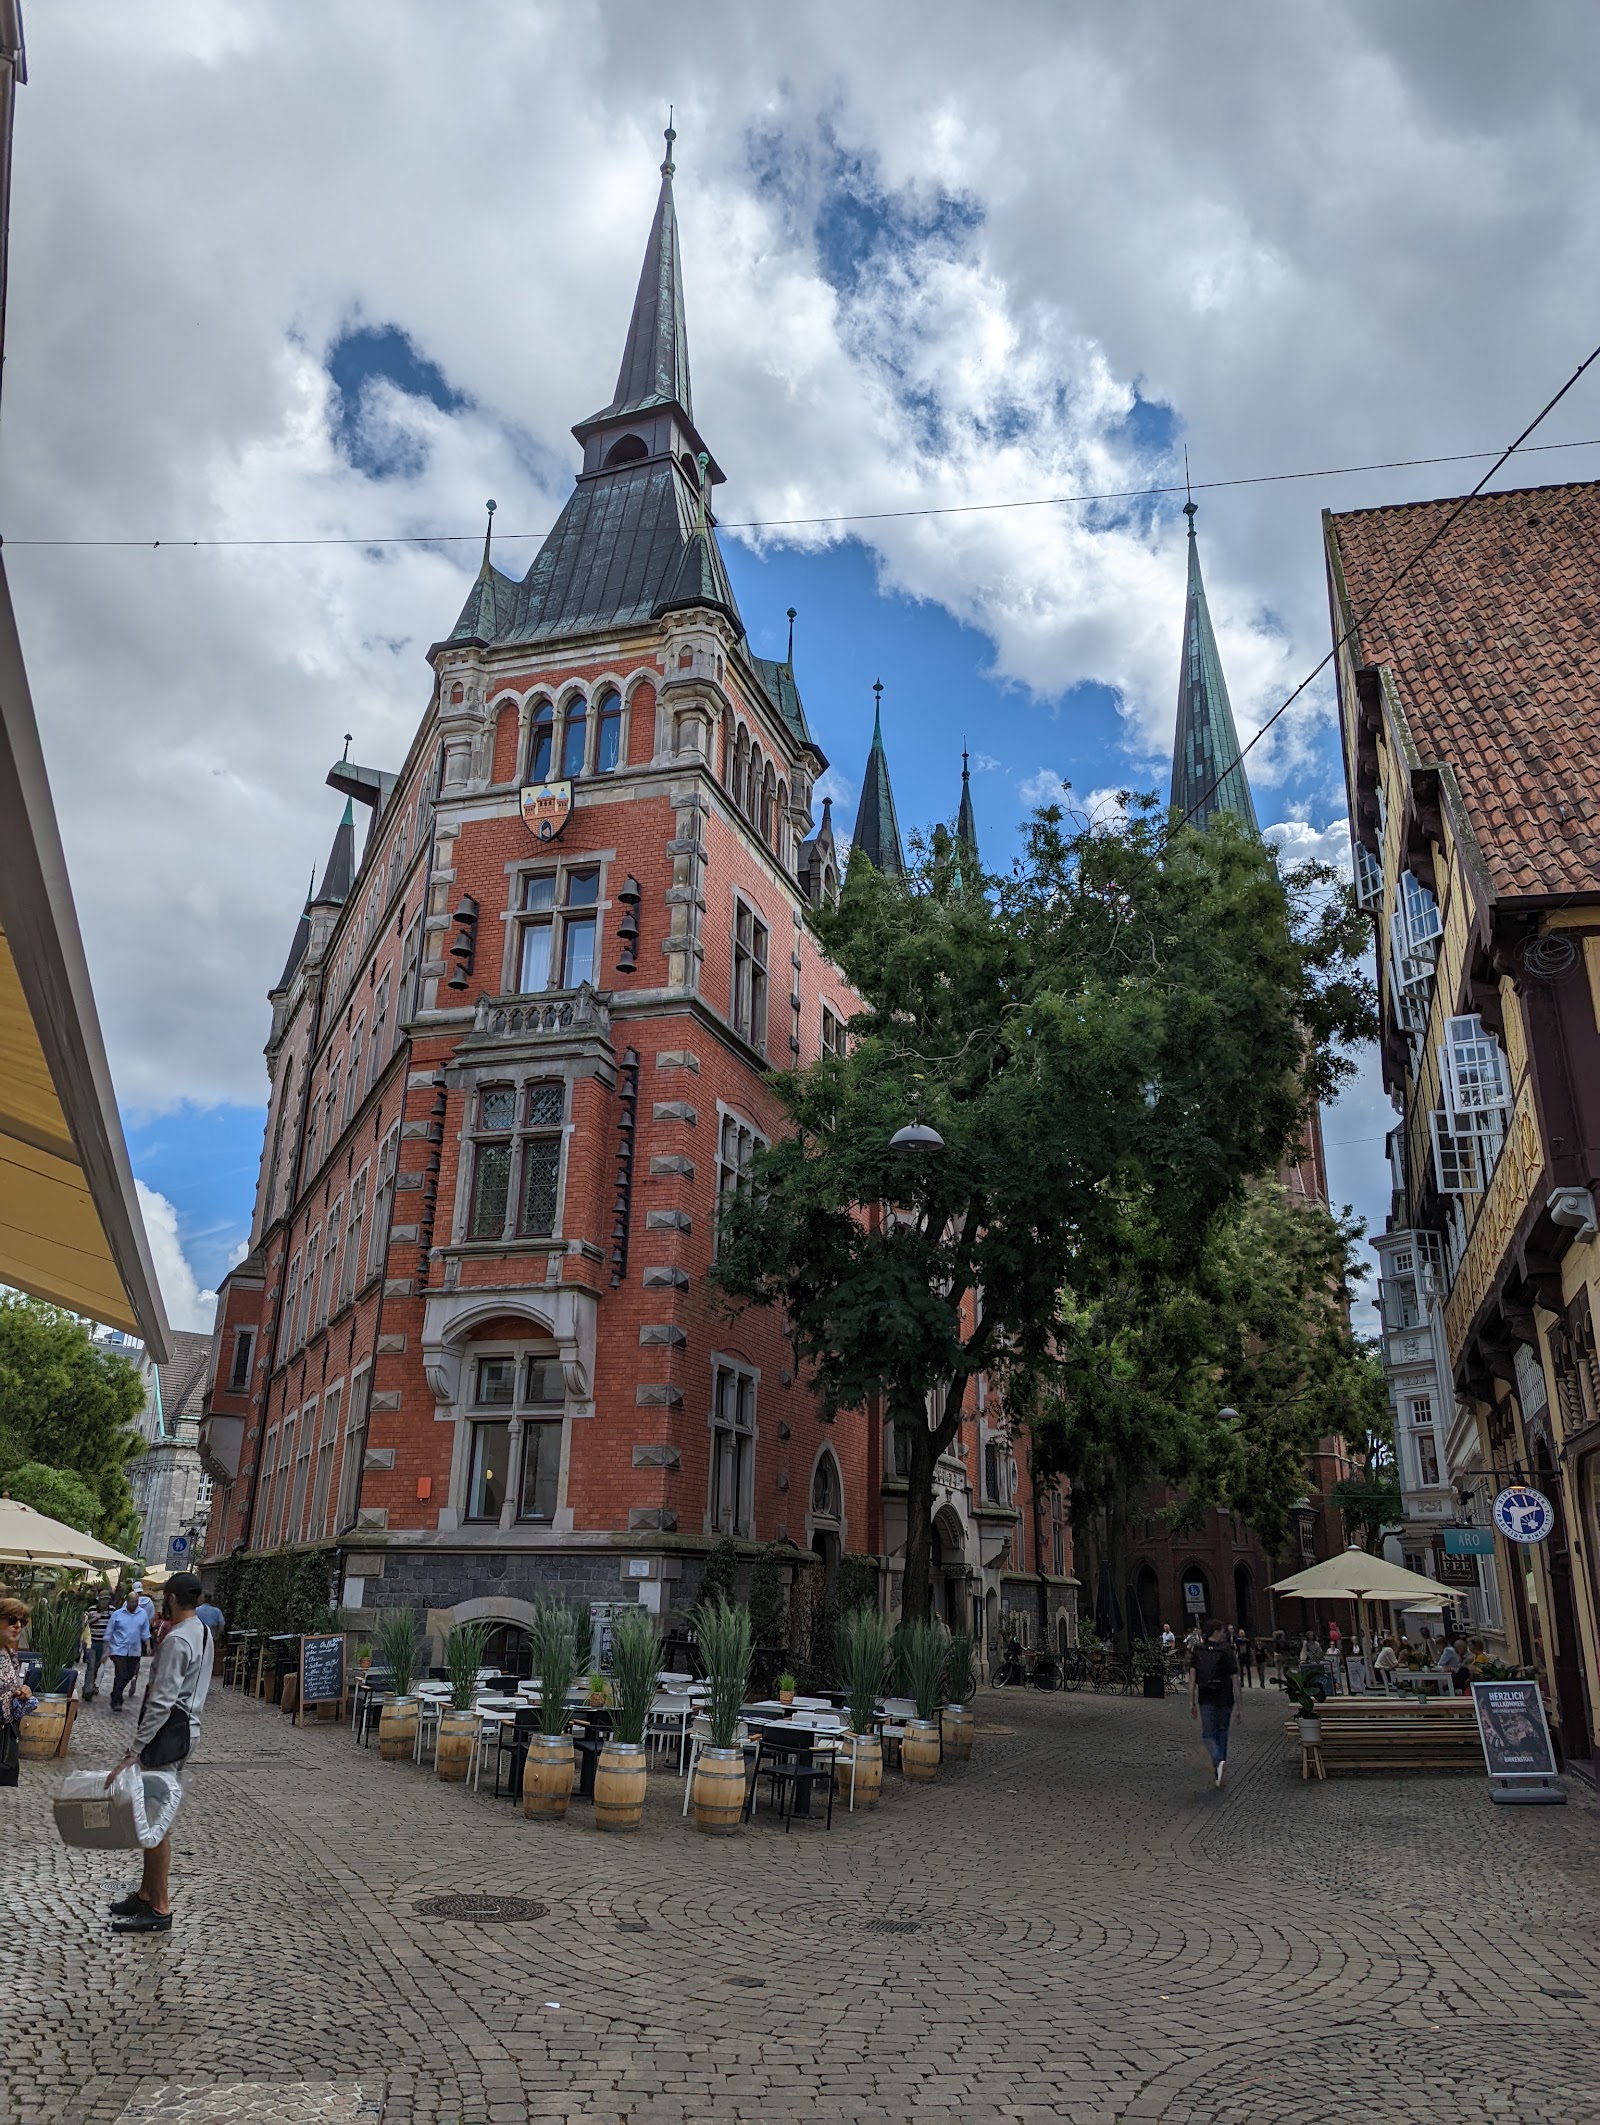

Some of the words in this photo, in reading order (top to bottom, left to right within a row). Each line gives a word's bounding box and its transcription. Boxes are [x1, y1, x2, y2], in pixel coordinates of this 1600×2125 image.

[1499, 1488, 1546, 1504] BIRKENSTOCK
[1496, 1509, 1523, 1539] TRADITION
[1527, 1529, 1546, 1539] SINCE
[1442, 1561, 1471, 1571] FEE
[1489, 1691, 1525, 1701] HERZLICH
